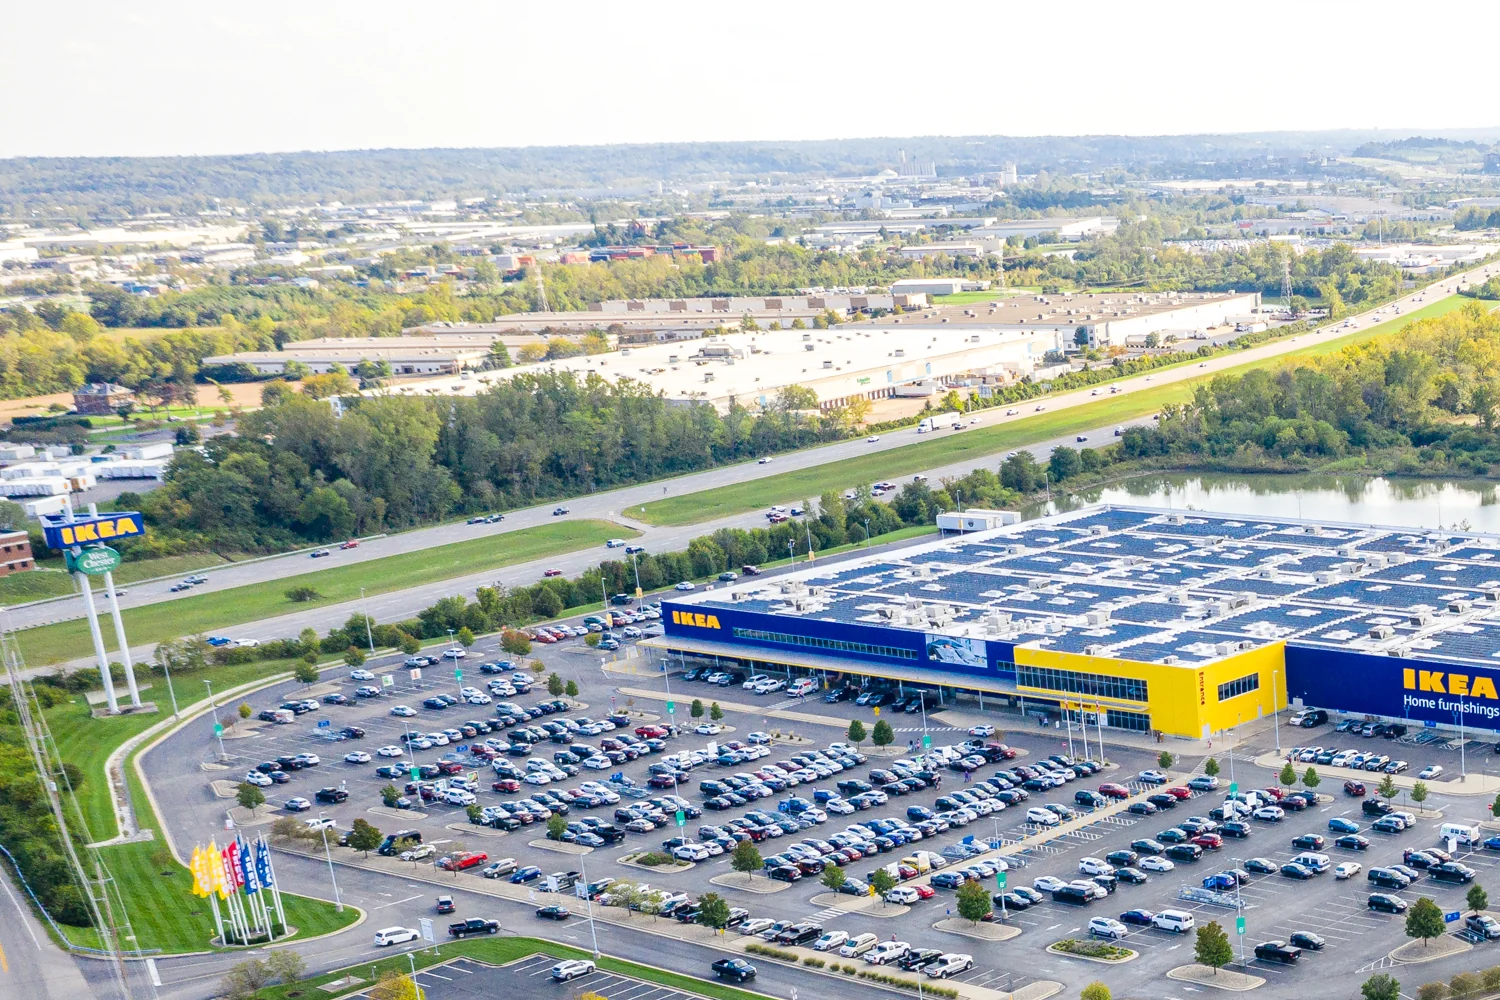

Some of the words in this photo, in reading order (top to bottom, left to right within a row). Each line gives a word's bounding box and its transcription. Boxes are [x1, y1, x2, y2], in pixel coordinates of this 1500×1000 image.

[61, 518, 138, 544] IKEA
[672, 611, 721, 629] IKEA
[1403, 668, 1499, 699] IKEA
[1404, 694, 1436, 709] Home
[1438, 697, 1500, 719] furnishings
